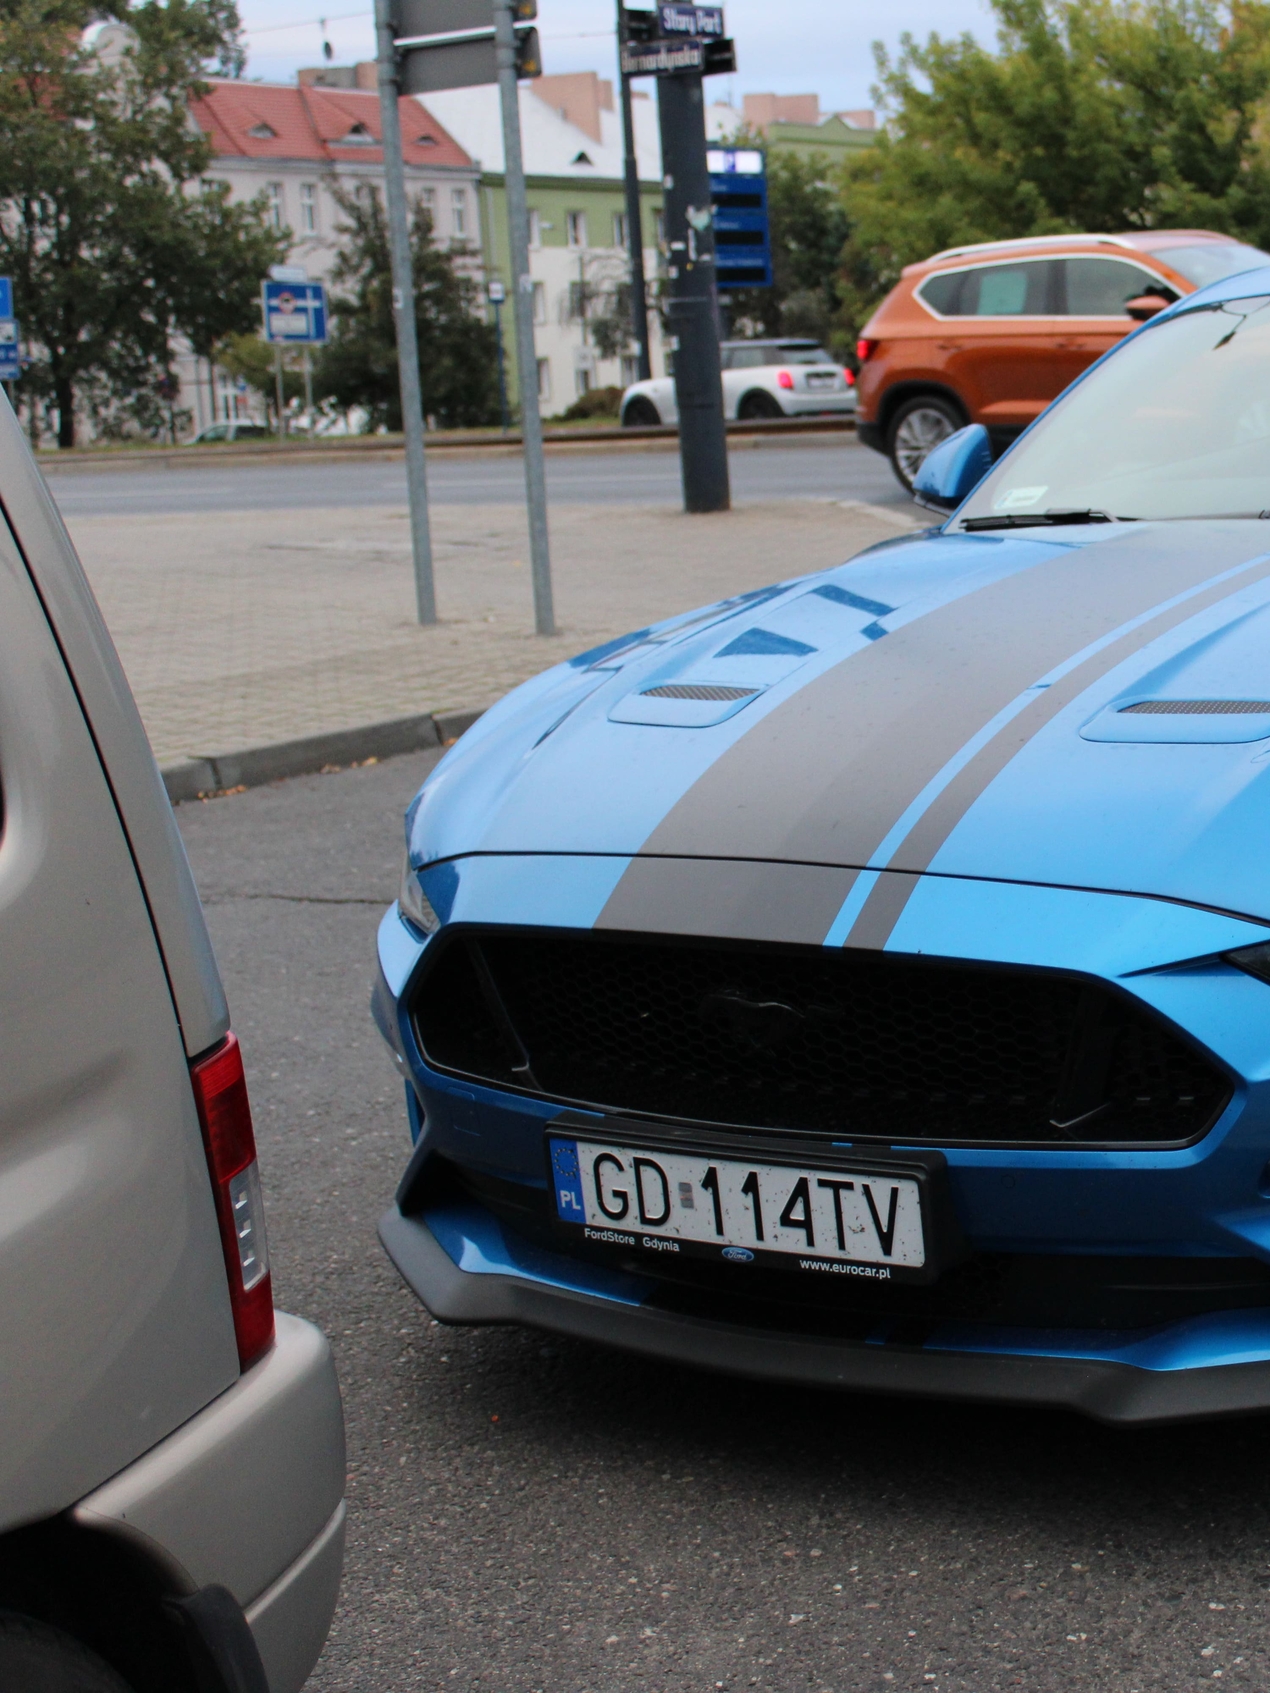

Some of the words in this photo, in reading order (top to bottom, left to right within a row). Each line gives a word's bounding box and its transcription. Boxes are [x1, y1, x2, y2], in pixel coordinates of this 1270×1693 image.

[663, 7, 696, 36] Stary
[560, 1189, 581, 1211] PL
[592, 1152, 671, 1227] GD
[700, 1166, 900, 1258] 114TV
[584, 1228, 635, 1246] FordStore
[643, 1237, 680, 1253] Gdynia
[726, 1248, 751, 1262] Ford
[799, 1258, 891, 1280] www.eurocar.pl
